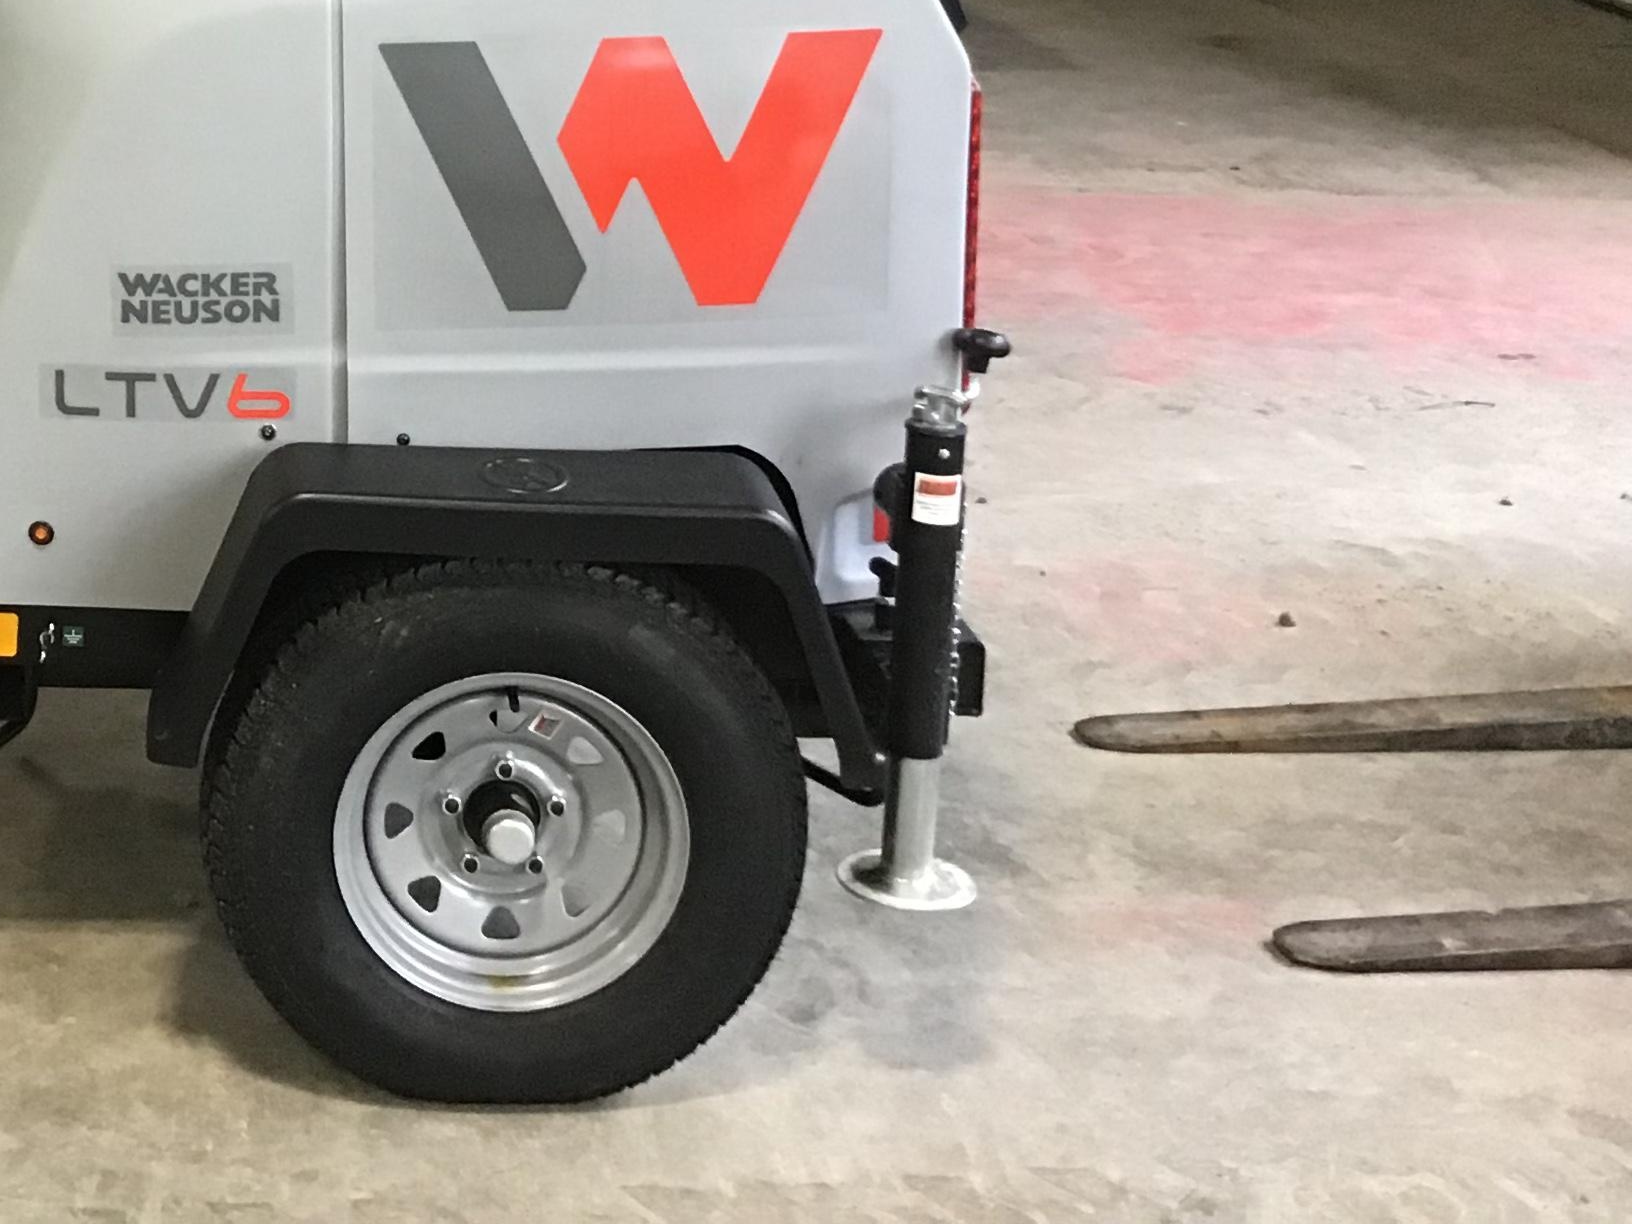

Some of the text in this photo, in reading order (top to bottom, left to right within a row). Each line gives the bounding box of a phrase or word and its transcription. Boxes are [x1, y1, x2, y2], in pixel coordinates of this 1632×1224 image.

[117, 272, 280, 297] WACKER
[120, 298, 280, 324] NEUSON
[54, 369, 291, 419] LTV6
